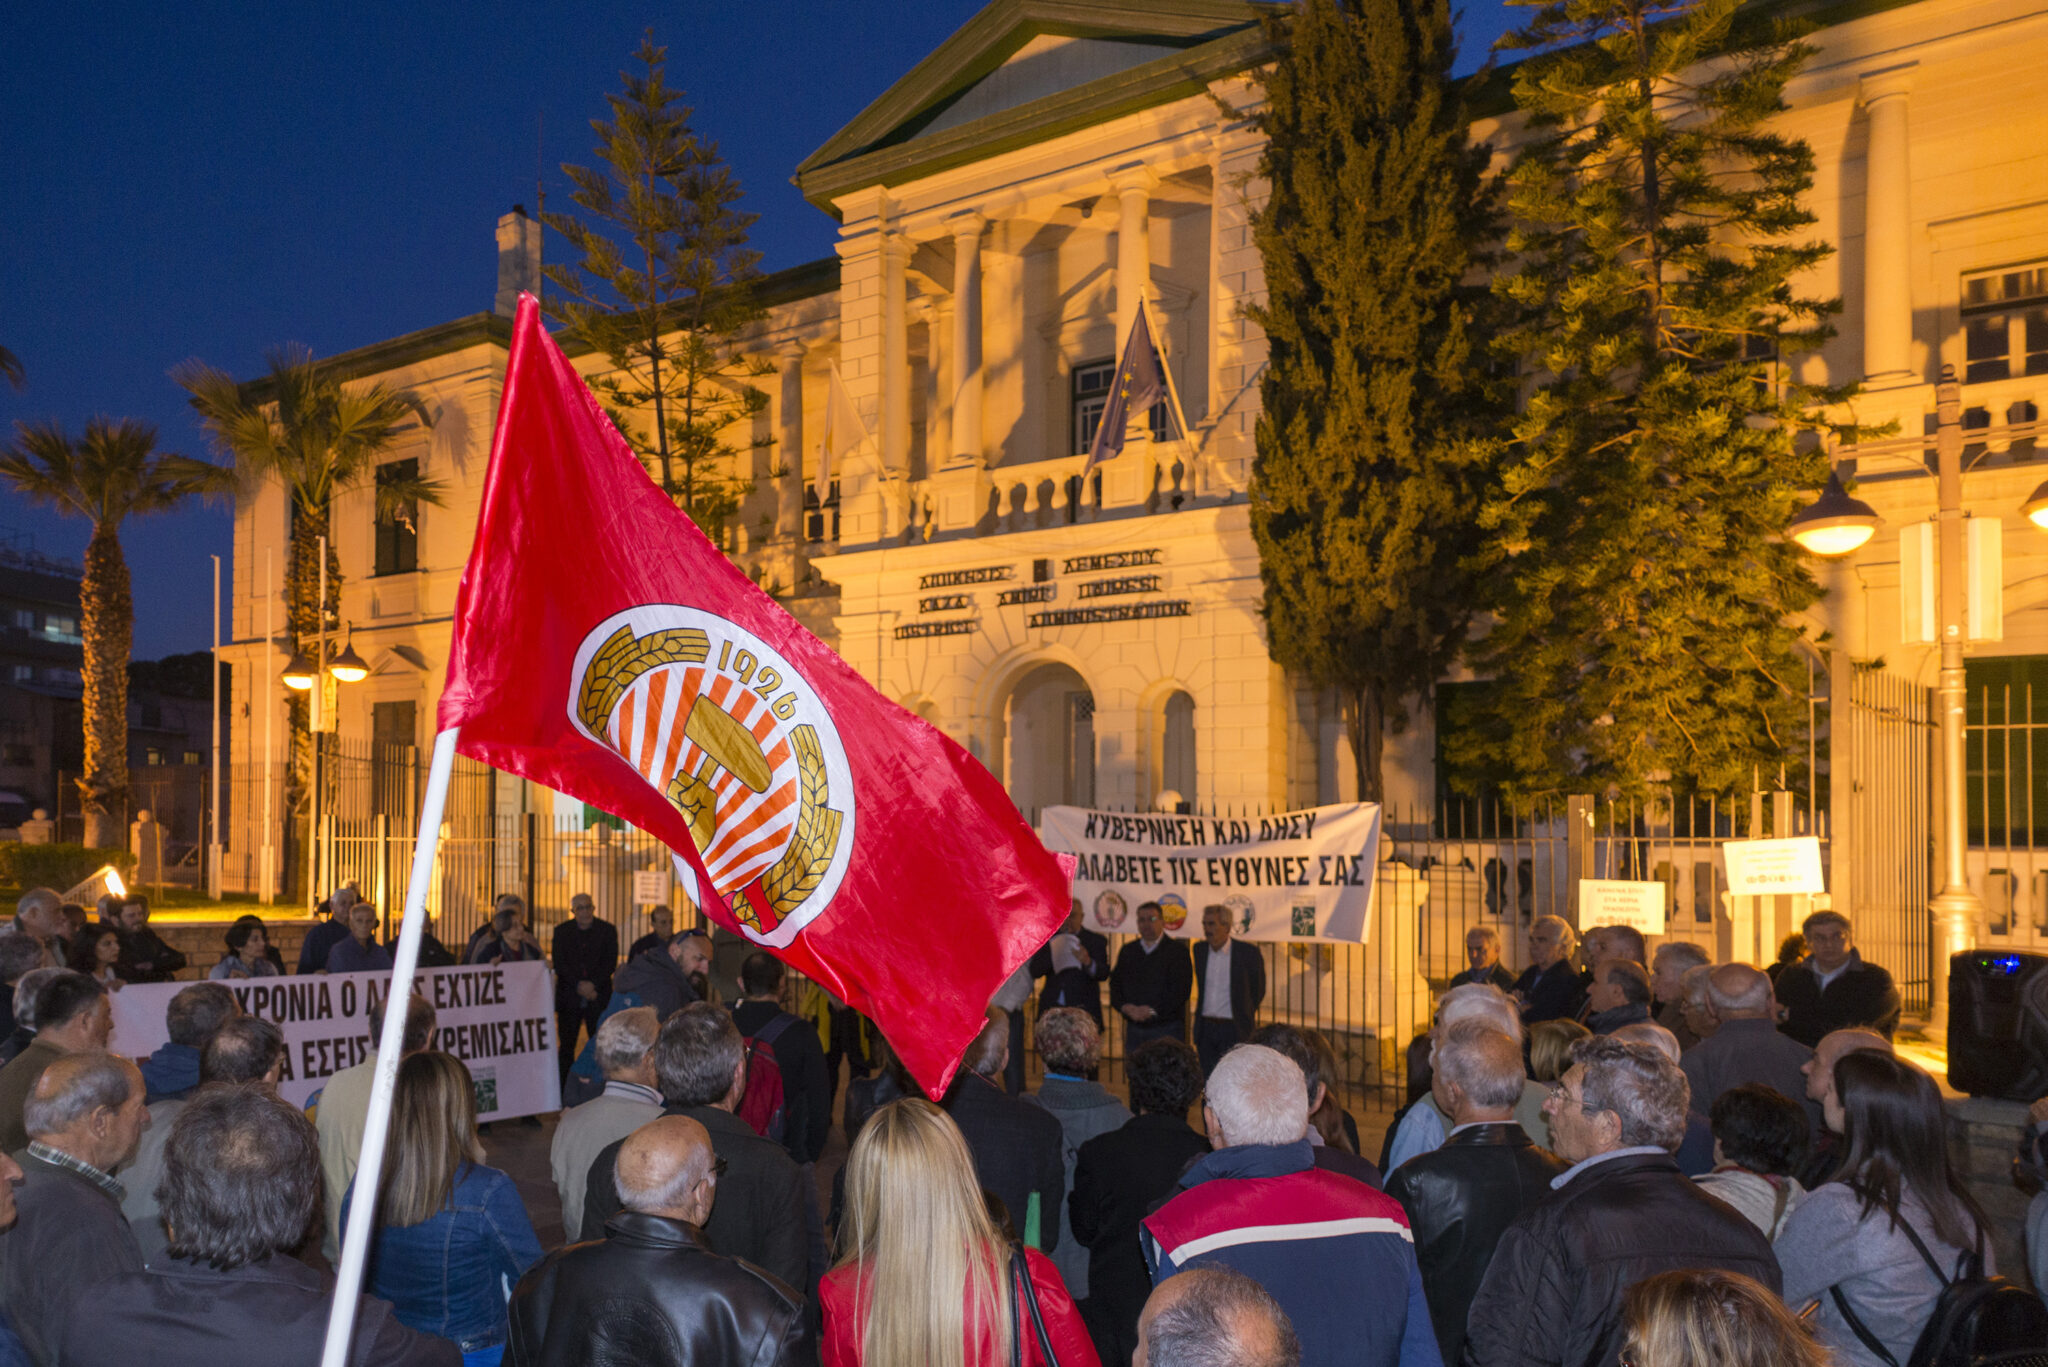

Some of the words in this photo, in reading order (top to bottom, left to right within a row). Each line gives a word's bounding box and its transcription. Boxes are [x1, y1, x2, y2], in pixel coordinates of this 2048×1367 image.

[1063, 548, 1162, 574] ΛΕΜΕΣΟΥ
[919, 595, 970, 614] KAZA
[895, 619, 976, 640] DISTRICT
[718, 639, 798, 721] 1926
[1085, 813, 1206, 846] ΚΥΒΕΡΝΗΣΗ
[1213, 818, 1250, 845] ΚΑΙ
[1257, 812, 1317, 842] ΔΗΣΥ
[1063, 852, 1163, 884] ΑΛΑΒΕΤΕ
[1167, 857, 1200, 885] ΤΙΣ
[1207, 856, 1309, 886] ΕΥΘΥΝΕΣ
[1318, 855, 1364, 886] ΣΑΣ
[234, 982, 333, 1024] ΧΡΟΝΙΑ
[434, 971, 506, 1009] ΕΧΤΙΖΕ
[302, 1035, 369, 1079] ΕΣΕΙΣ
